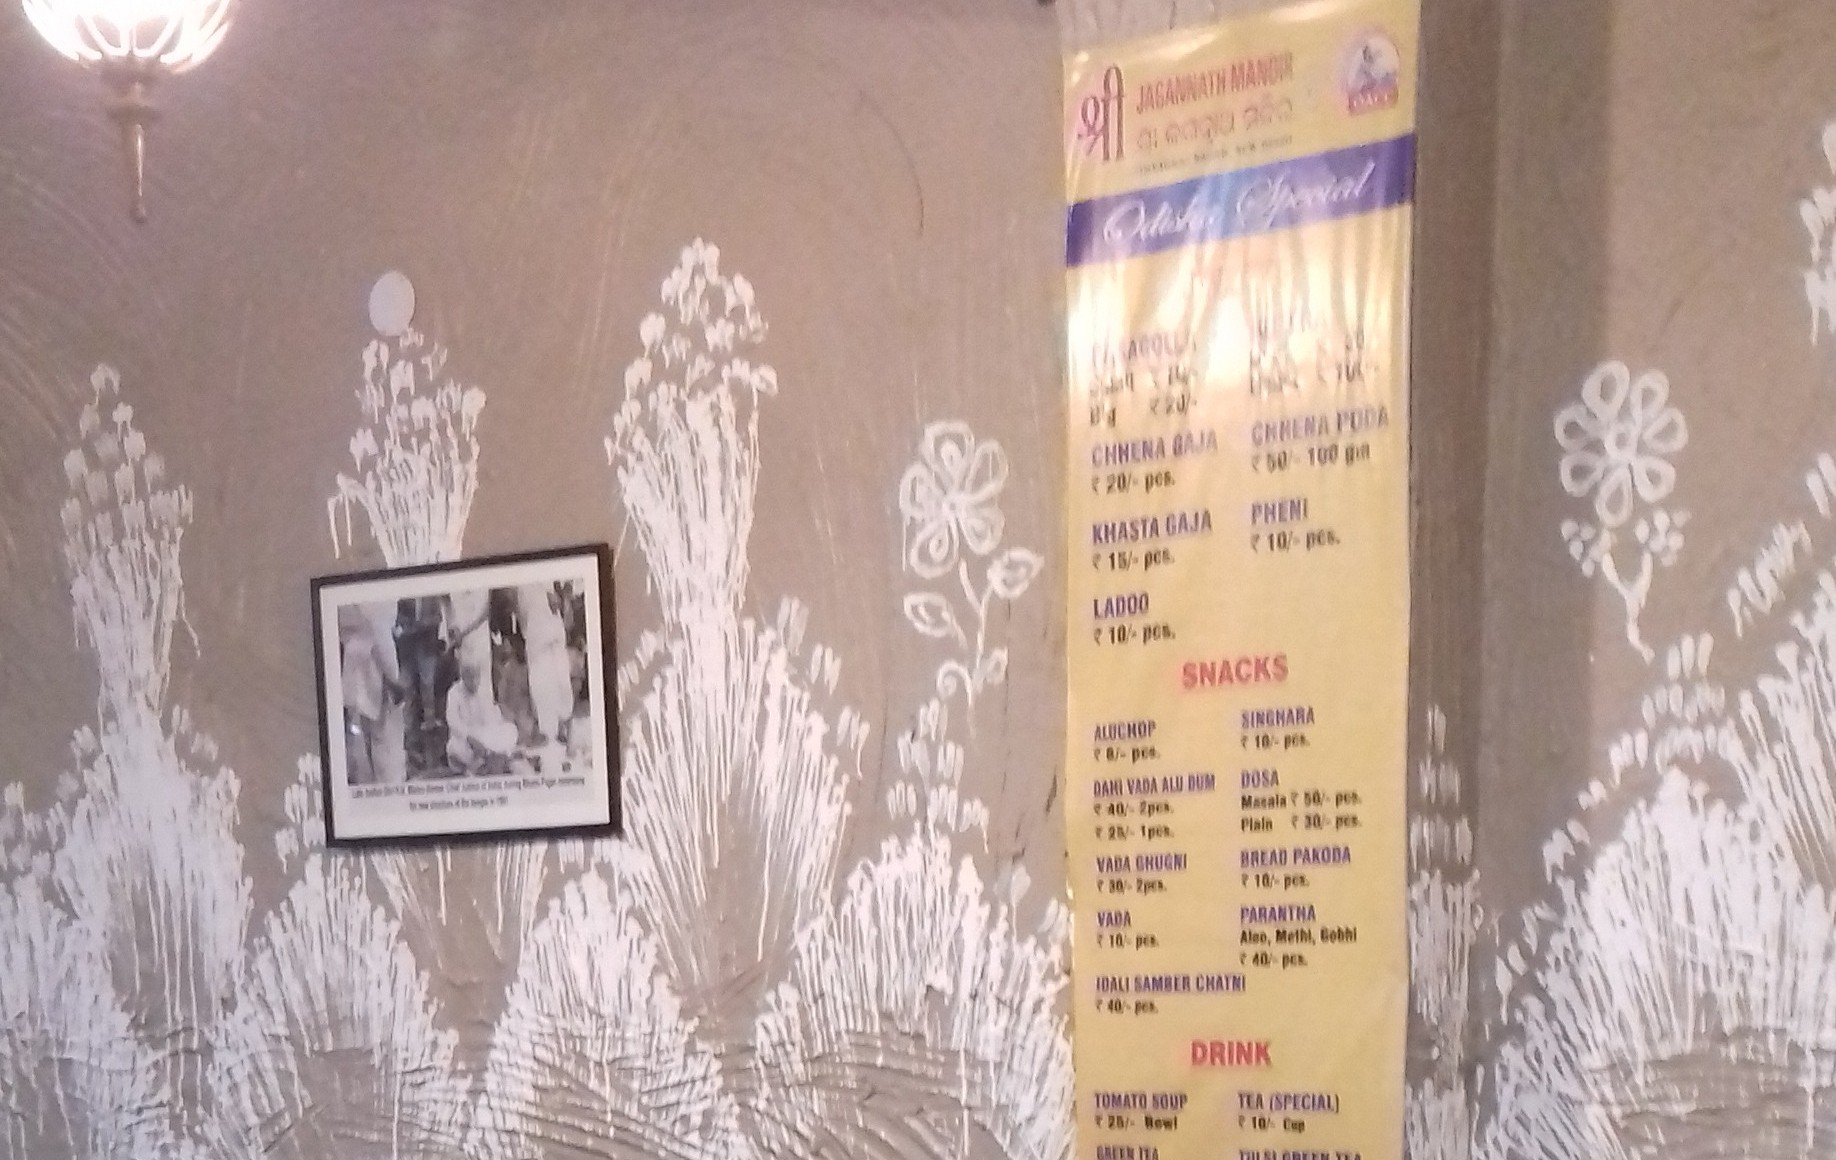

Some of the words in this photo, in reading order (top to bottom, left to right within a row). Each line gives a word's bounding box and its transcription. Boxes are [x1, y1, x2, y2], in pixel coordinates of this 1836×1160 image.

[1136, 69, 1226, 114] JAGANNATH
[1252, 413, 1330, 445] CHHENA
[1092, 436, 1165, 468] CHHENA
[1172, 429, 1217, 457] GAJA
[1106, 472, 1139, 494] 20/-
[1145, 469, 1176, 494] pcs.
[1252, 498, 1308, 524] PHENI
[1092, 516, 1159, 544] KHASTA
[1166, 509, 1212, 534] GAJA
[1268, 531, 1299, 552] 10/-
[1306, 529, 1340, 551] pcs.
[1109, 551, 1139, 571] 15/-
[1144, 549, 1175, 571] pcs.
[1094, 592, 1149, 619] LADOO
[1109, 625, 1136, 645] 10/-
[1143, 624, 1176, 645] pcs.
[1182, 655, 1288, 688] SNACKS
[1241, 707, 1314, 729] SINGHARA
[1094, 721, 1156, 741] ALUCHOP
[1094, 778, 1122, 797] DAHI
[1128, 777, 1158, 794] VADA
[1162, 776, 1183, 794] ALU
[1188, 774, 1215, 792] DUM
[1241, 770, 1279, 788] DOSA
[1241, 792, 1286, 810] Masala
[1241, 817, 1273, 832] Plain
[1097, 856, 1131, 874] VADA
[1241, 849, 1287, 868] BREAD
[1293, 846, 1351, 866] PAKODA
[1098, 911, 1131, 928] VADA
[1241, 905, 1316, 924] PARANTHA
[1196, 975, 1246, 992] CHATNI
[1191, 1040, 1272, 1066] DRINK
[1095, 1093, 1148, 1110] TOMATO
[1152, 1093, 1187, 1110] SOUP
[1239, 1093, 1263, 1111] TEA
[1269, 1093, 1340, 1113] (SPECIAL)
[1283, 1118, 1305, 1133] Cup
